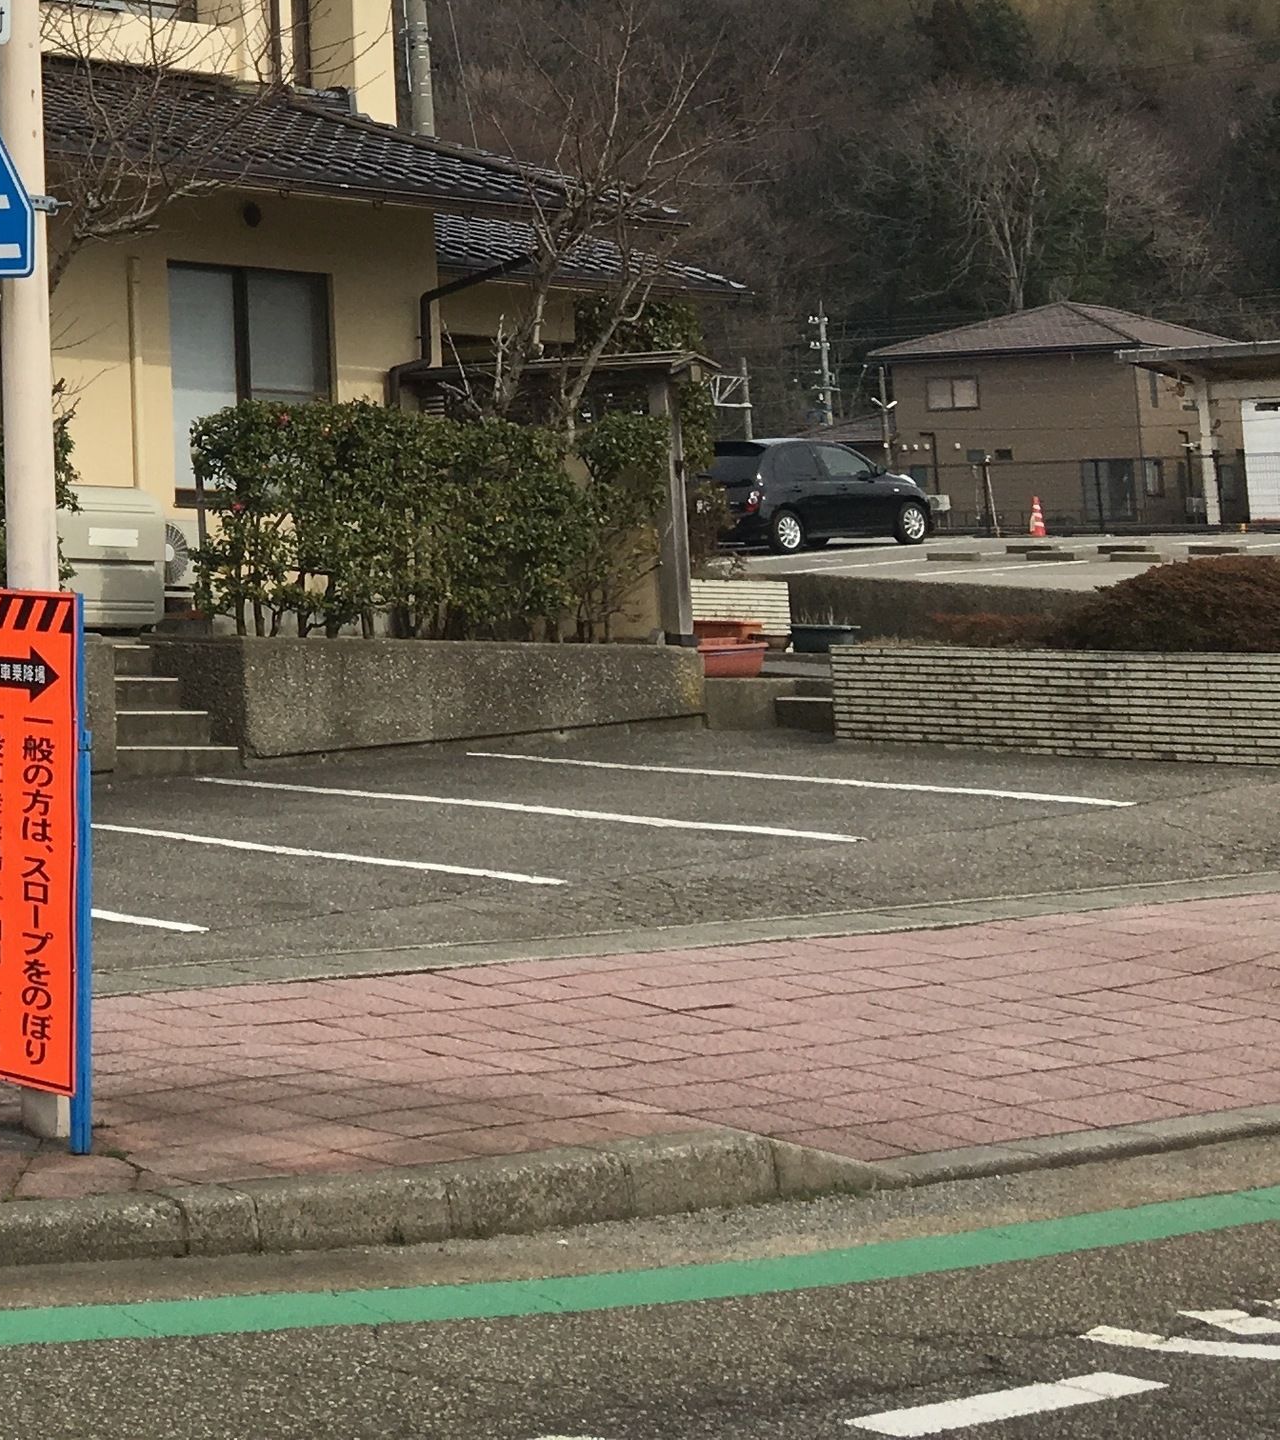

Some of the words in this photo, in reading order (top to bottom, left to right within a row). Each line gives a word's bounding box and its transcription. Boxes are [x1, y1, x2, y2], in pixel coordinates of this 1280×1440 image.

[21, 716, 55, 1066] 一般の方は、スロープをのぼり
